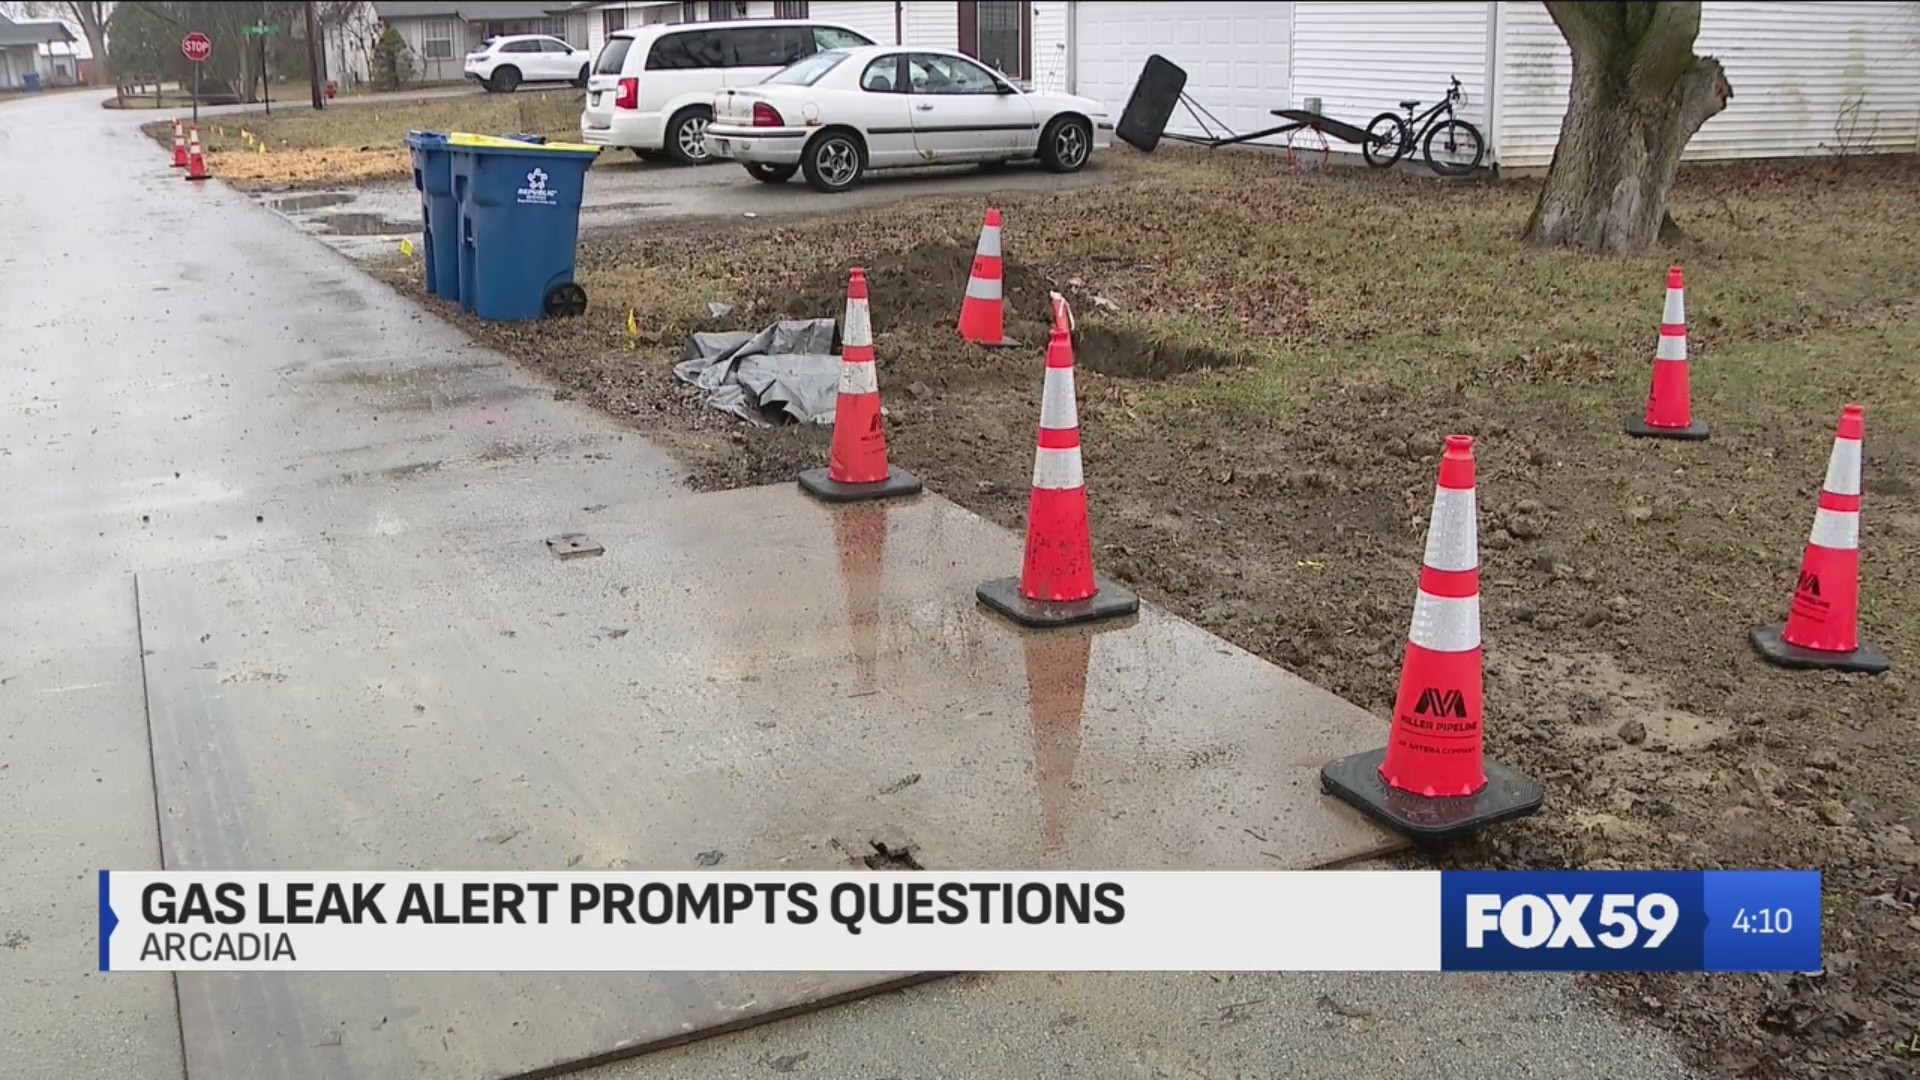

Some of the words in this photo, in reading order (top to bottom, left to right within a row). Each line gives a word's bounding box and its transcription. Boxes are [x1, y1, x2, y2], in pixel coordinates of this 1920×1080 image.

[185, 41, 209, 52] STOP
[1401, 714, 1433, 730] MILLER
[1436, 721, 1478, 732] PIPELINE
[1442, 746, 1477, 755] COMPANY
